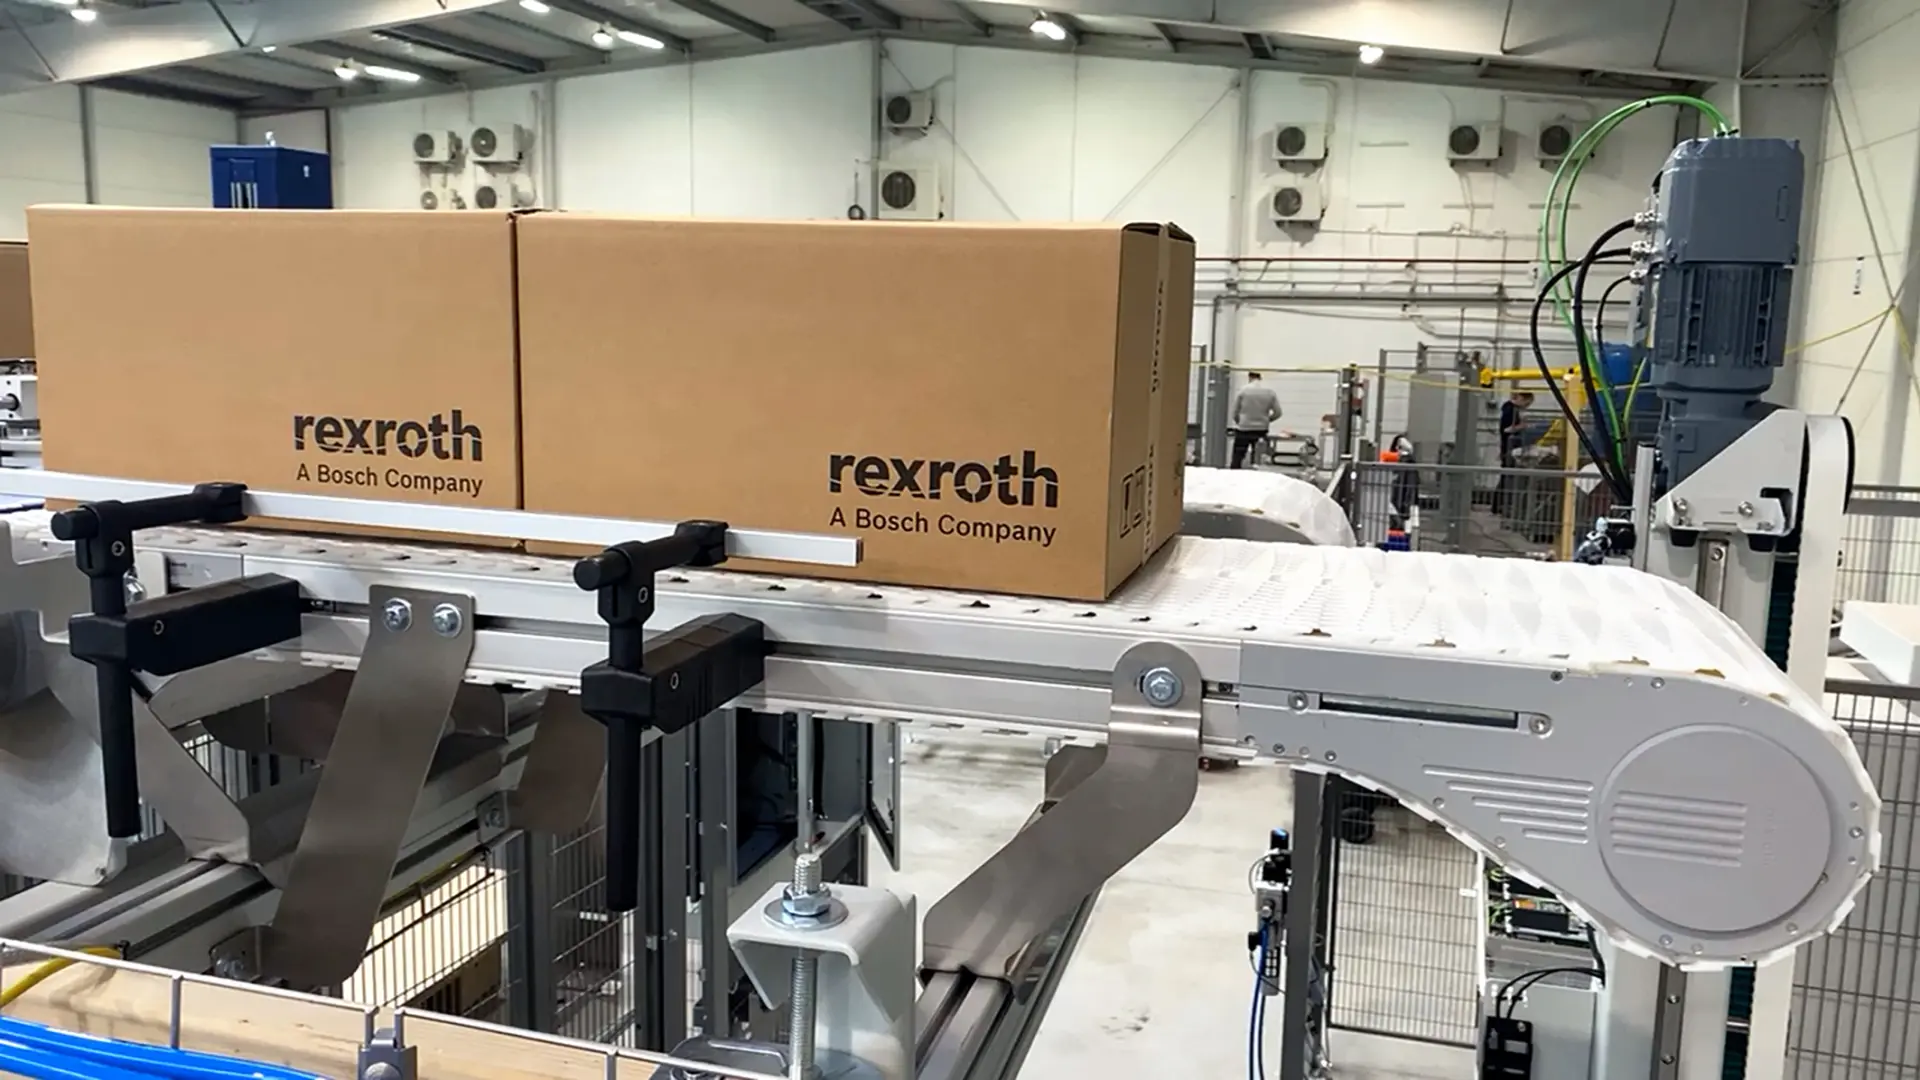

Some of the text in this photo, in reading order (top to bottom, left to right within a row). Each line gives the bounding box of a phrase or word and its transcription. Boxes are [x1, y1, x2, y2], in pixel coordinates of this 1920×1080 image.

[294, 409, 482, 461] rexroth
[296, 463, 482, 498] A Bosch Company
[829, 449, 1058, 508] rexroth
[829, 507, 1056, 548] A Bosch Company
